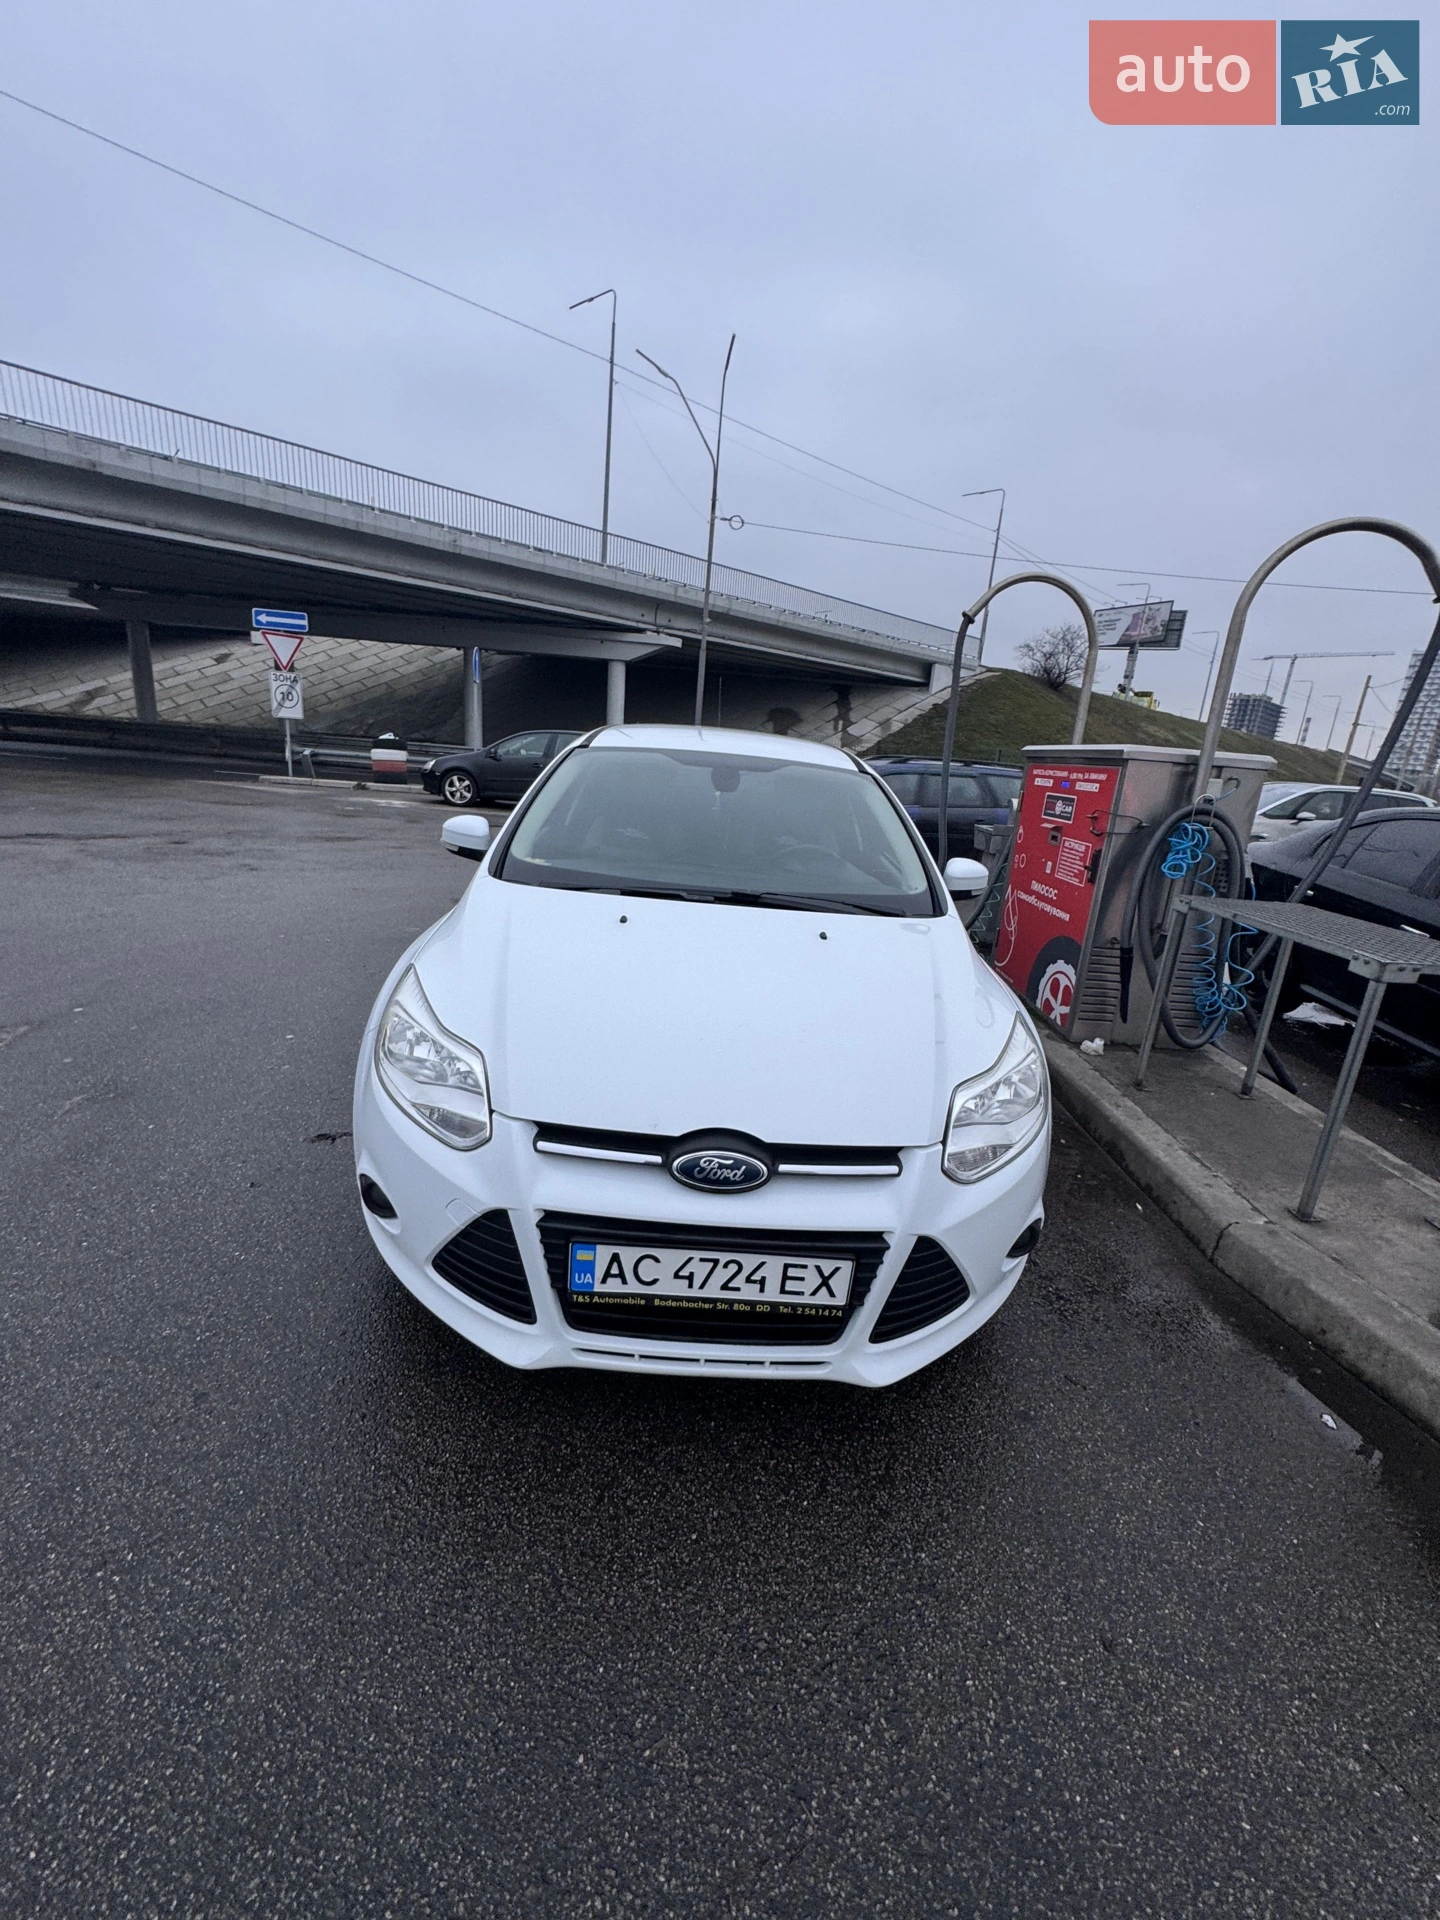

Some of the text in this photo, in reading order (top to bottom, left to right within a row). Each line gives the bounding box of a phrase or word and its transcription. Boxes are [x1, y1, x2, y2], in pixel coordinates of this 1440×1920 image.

[272, 672, 299, 684] ЗОНА
[279, 691, 294, 702] 10
[693, 1156, 747, 1182] Ford
[574, 1272, 593, 1285] UA
[600, 1251, 843, 1298] AC 4724 EX
[572, 1294, 590, 1303] T&S
[592, 1295, 646, 1305] Automobile
[654, 1298, 714, 1309] Bodenbacher
[716, 1302, 731, 1310] Str.
[756, 1304, 771, 1312] DD
[779, 1305, 794, 1313] Tel.
